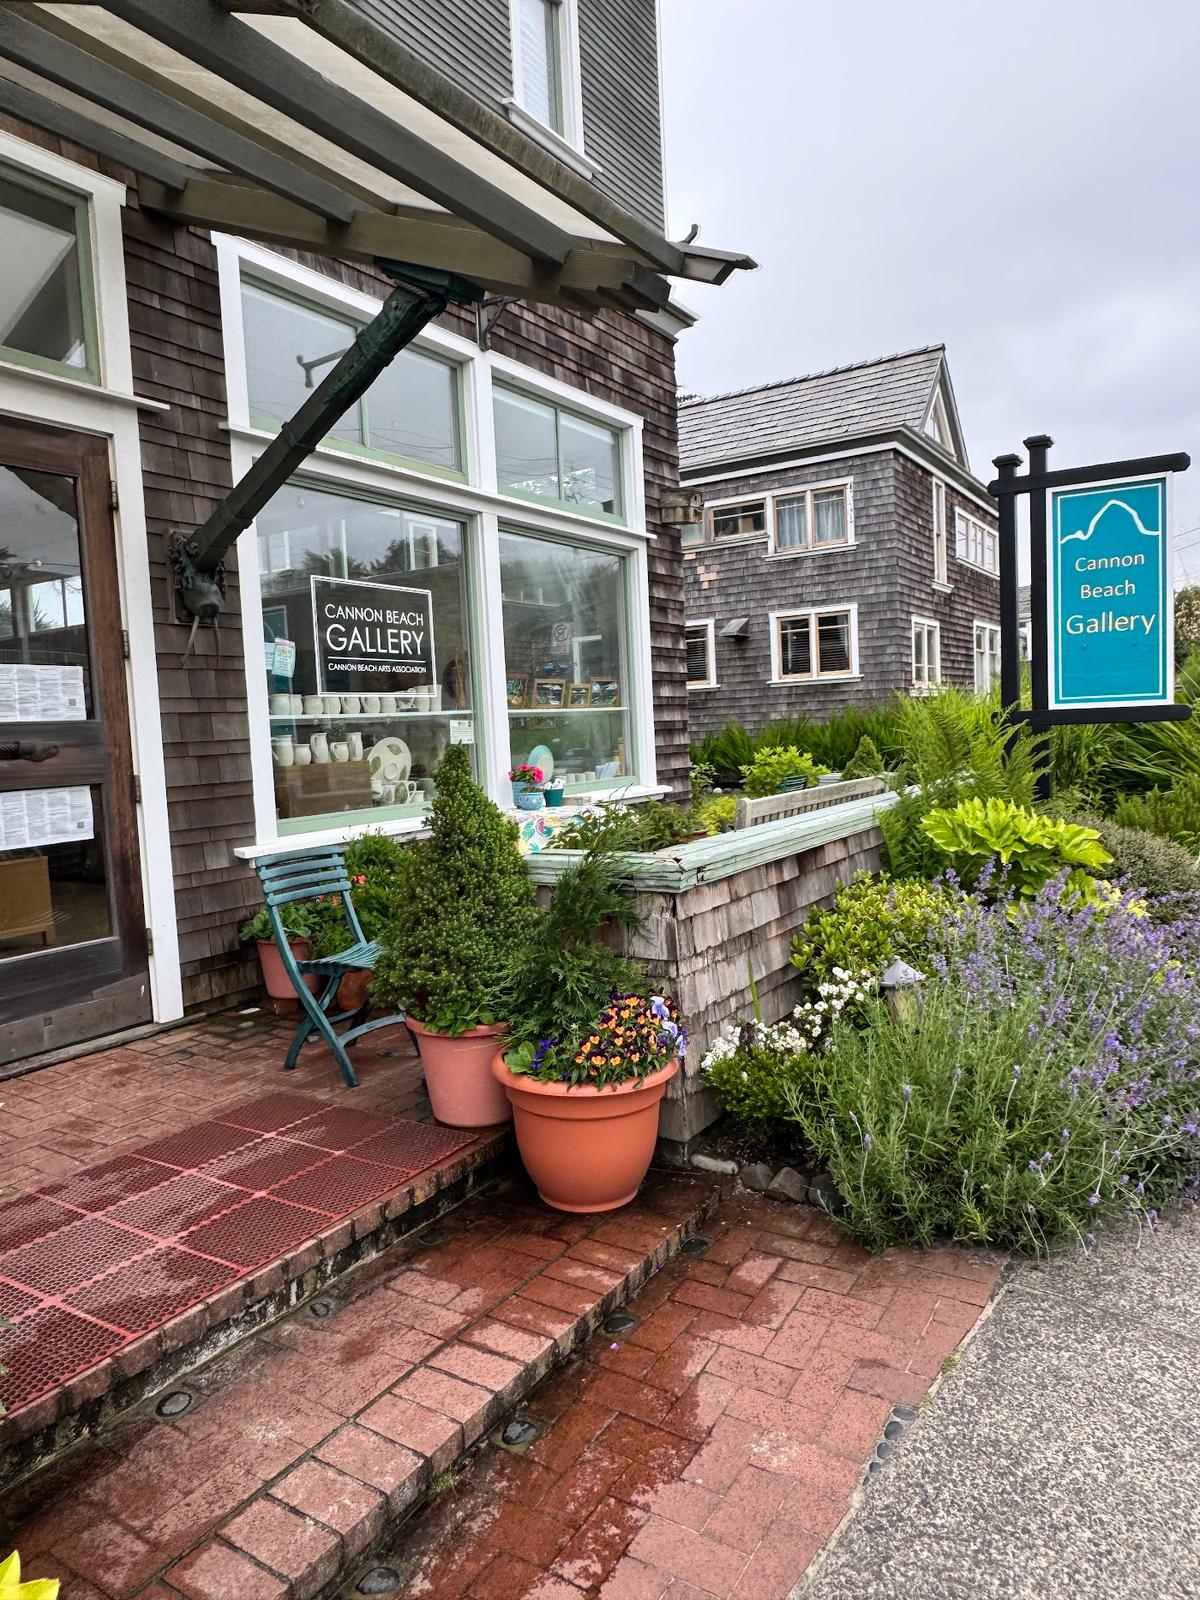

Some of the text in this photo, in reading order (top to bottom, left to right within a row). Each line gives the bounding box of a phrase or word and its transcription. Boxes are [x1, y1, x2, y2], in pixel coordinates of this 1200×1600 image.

[1075, 553, 1145, 572] Cannon
[1080, 579, 1136, 599] Beach
[325, 603, 424, 626] CANNON BEACH
[1066, 610, 1156, 635] Gallery
[326, 623, 424, 655] GALLERY
[328, 663, 427, 674] CANNON BEACH ARTS ASSOCIATION
